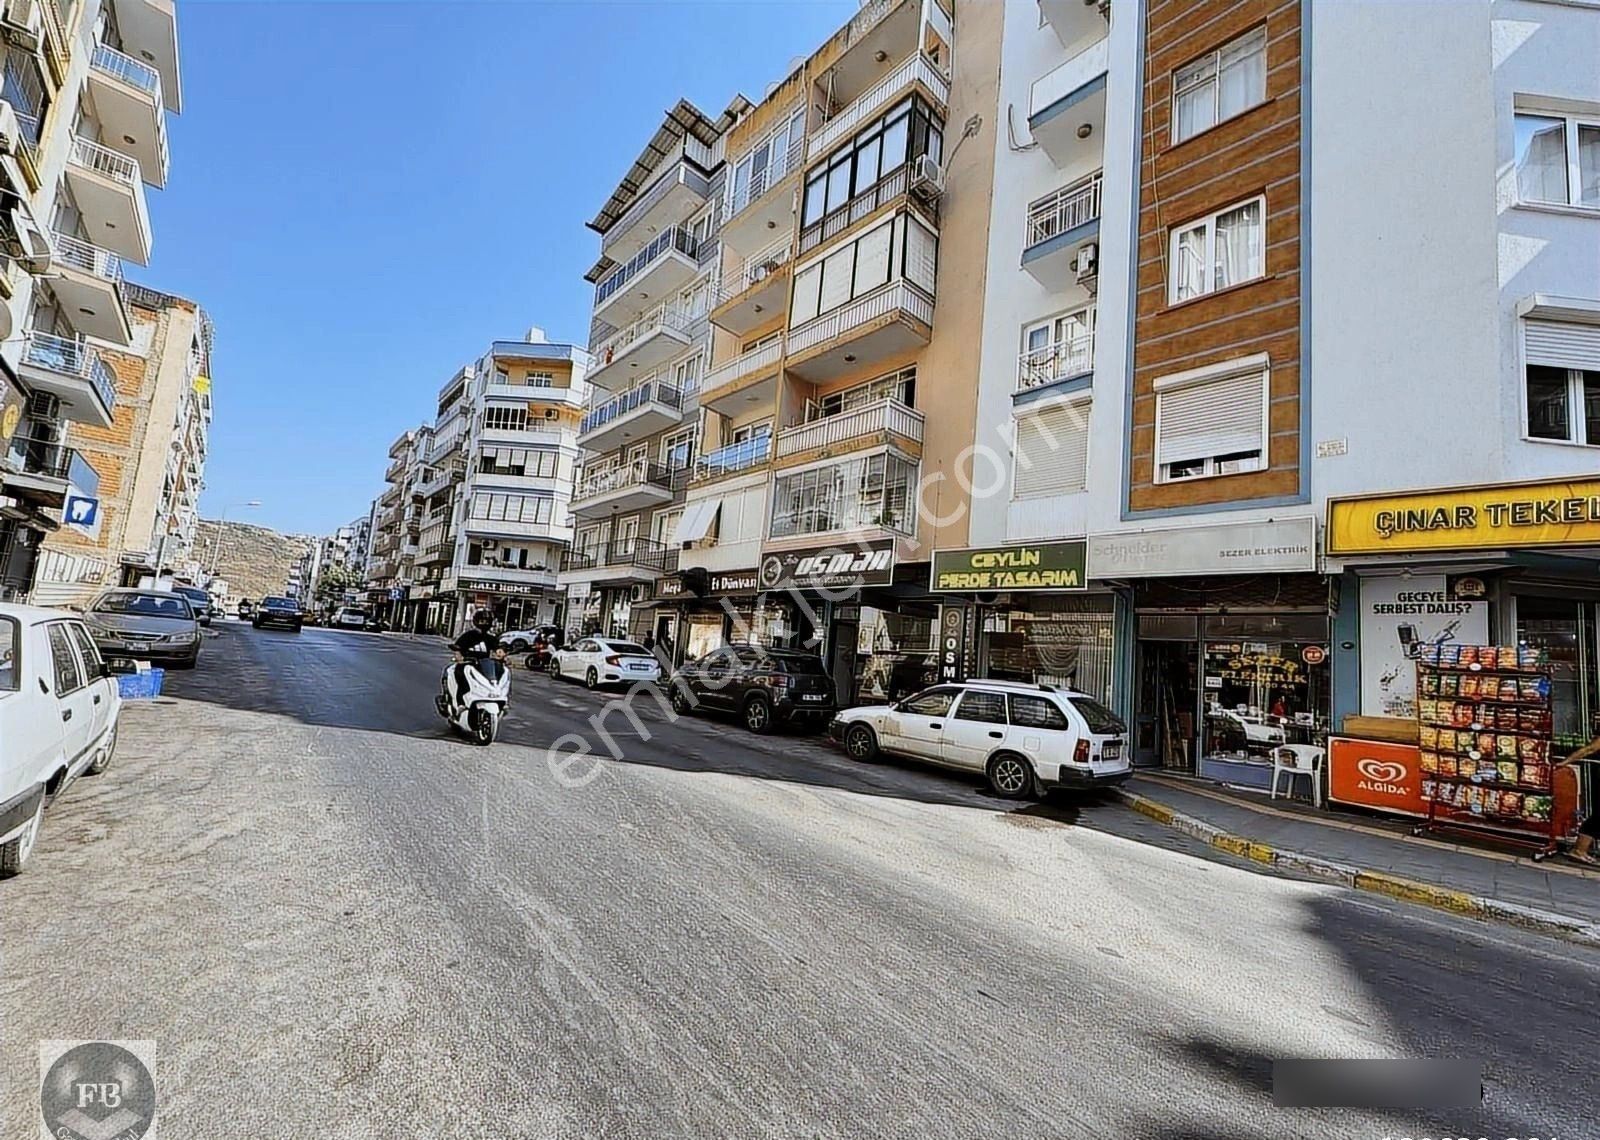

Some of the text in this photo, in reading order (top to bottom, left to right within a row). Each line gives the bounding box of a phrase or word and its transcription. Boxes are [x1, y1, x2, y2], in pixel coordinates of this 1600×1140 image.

[1375, 496, 1600, 538] ÇINAR TEKEL
[971, 549, 1040, 567] CEYLİN
[1219, 549, 1252, 558] SEZER
[939, 570, 1078, 588] PERDE TASARIM
[1397, 592, 1444, 603] GECEYE
[1373, 603, 1473, 616] SERBEST DALIŞ?
[943, 637, 957, 684] OSM
